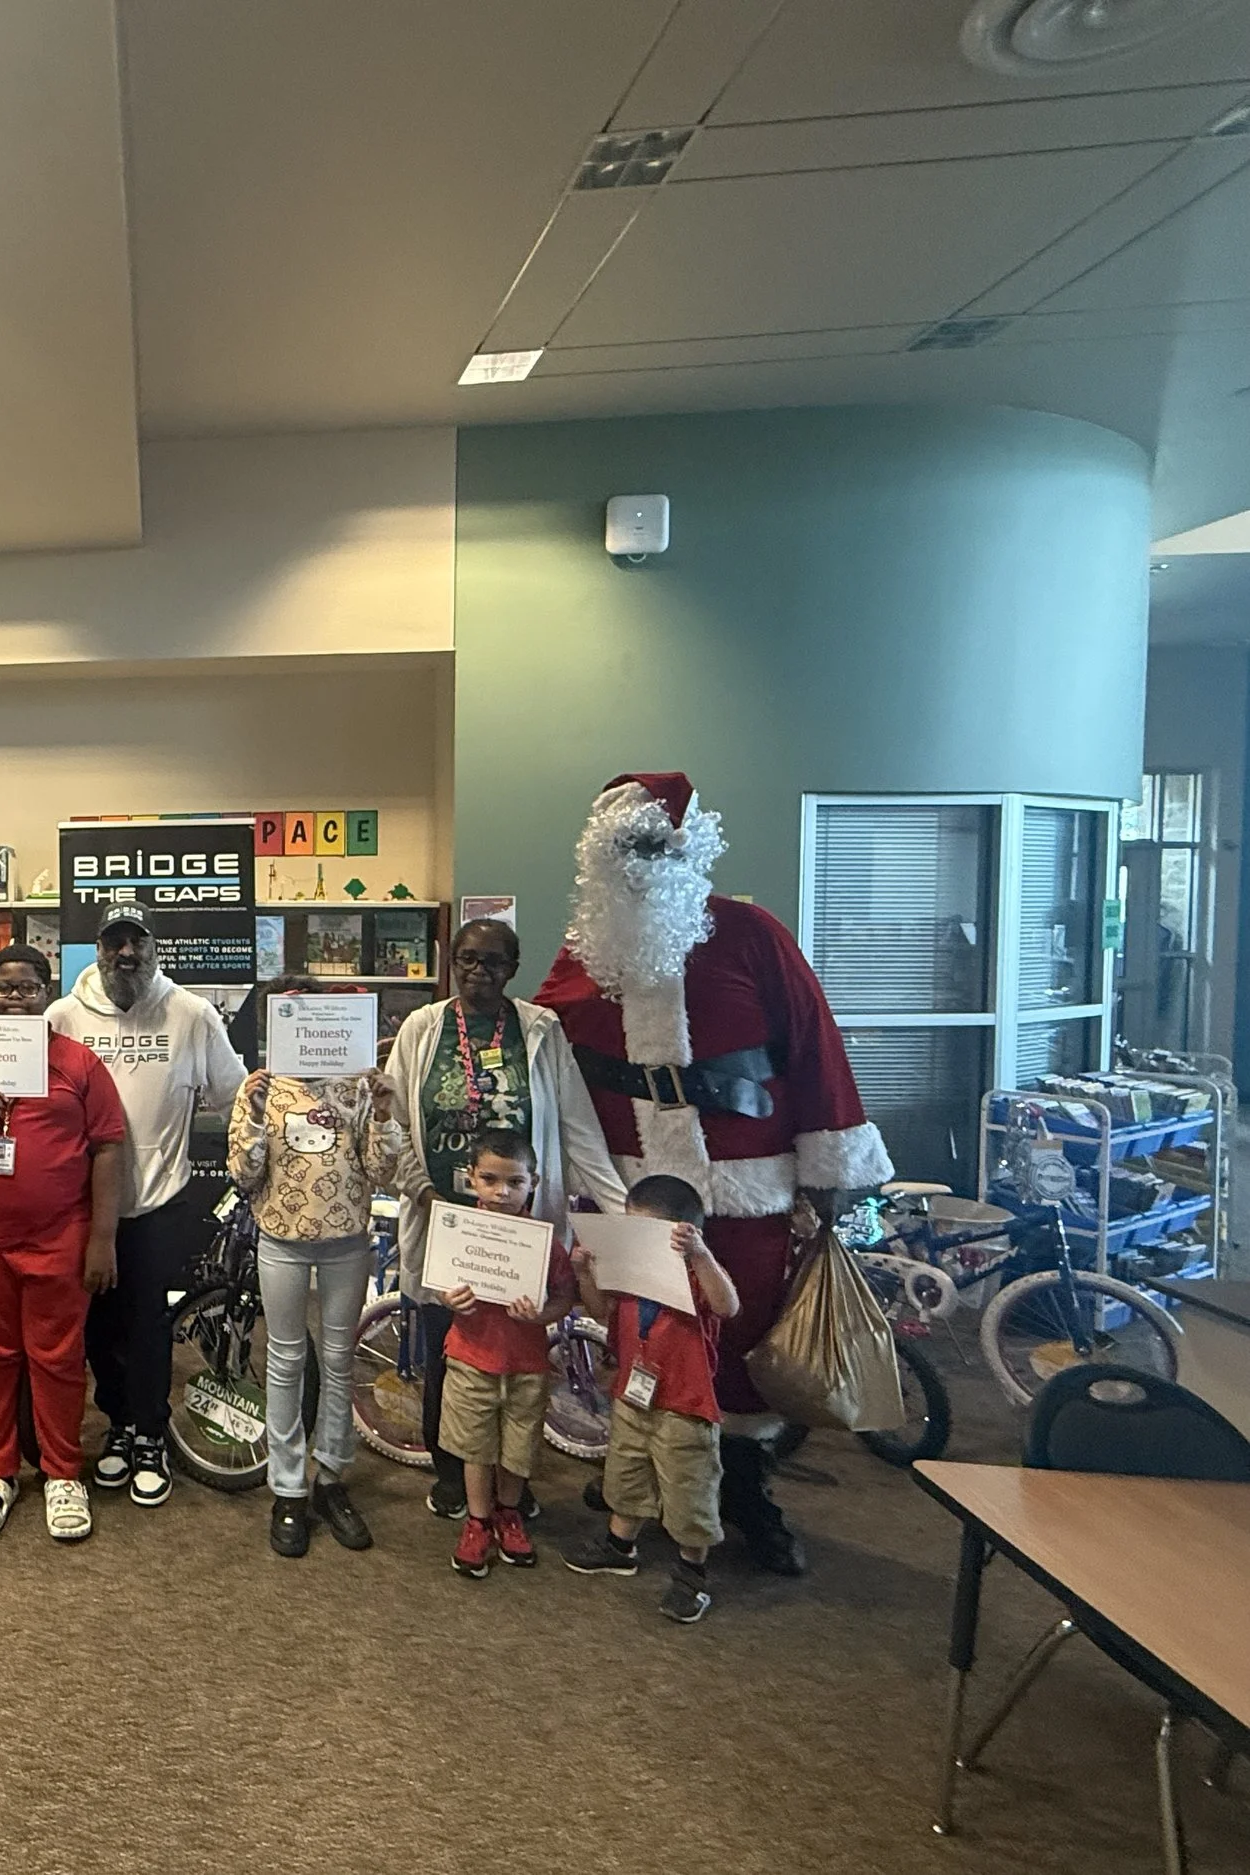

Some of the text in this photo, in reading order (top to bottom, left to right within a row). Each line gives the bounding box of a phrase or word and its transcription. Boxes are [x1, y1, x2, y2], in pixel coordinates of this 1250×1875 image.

[73, 886, 241, 903] THE GAPS
[212, 938, 250, 946] STUDENTS
[179, 946, 208, 954] SPORTS
[299, 1045, 348, 1056] Bennett
[123, 1053, 169, 1064] GAPS
[465, 1244, 510, 1263] Gilberto
[451, 1257, 520, 1281] Castanededa
[197, 1376, 259, 1417] MOUNTAIN
